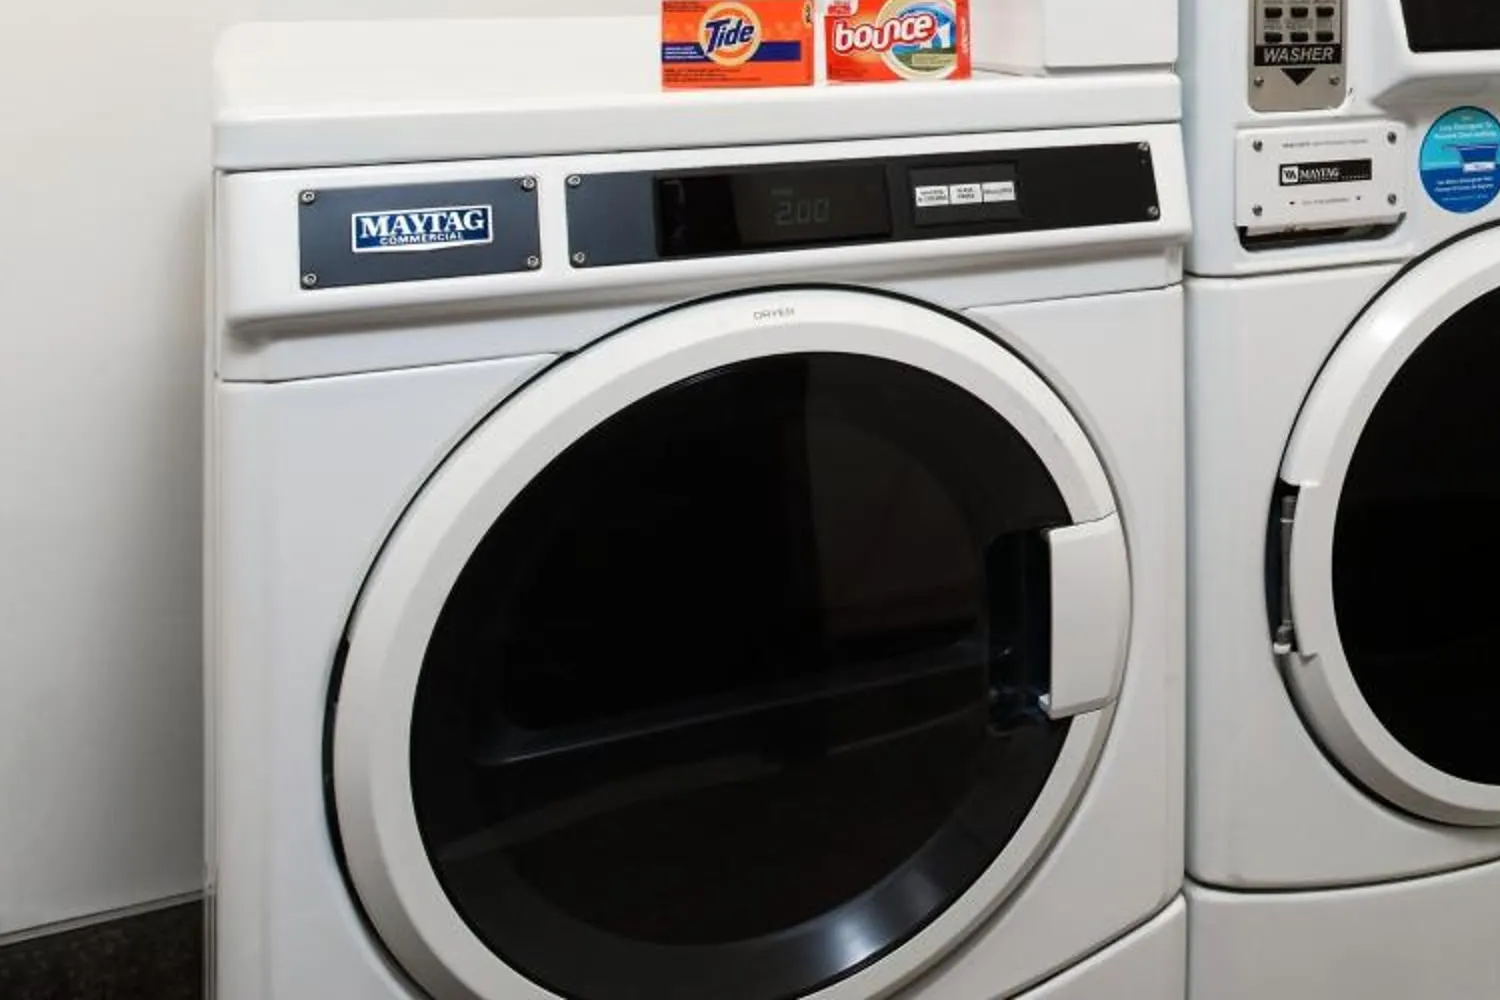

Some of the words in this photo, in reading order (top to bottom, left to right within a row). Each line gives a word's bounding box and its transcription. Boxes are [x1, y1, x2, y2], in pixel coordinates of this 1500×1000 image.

[703, 18, 755, 52] Tide
[834, 13, 933, 53] bounce
[1263, 46, 1334, 64] WASHER
[1300, 166, 1340, 180] MAYTAG
[360, 209, 485, 238] MAYTAG
[379, 231, 465, 246] COMMERCIAL
